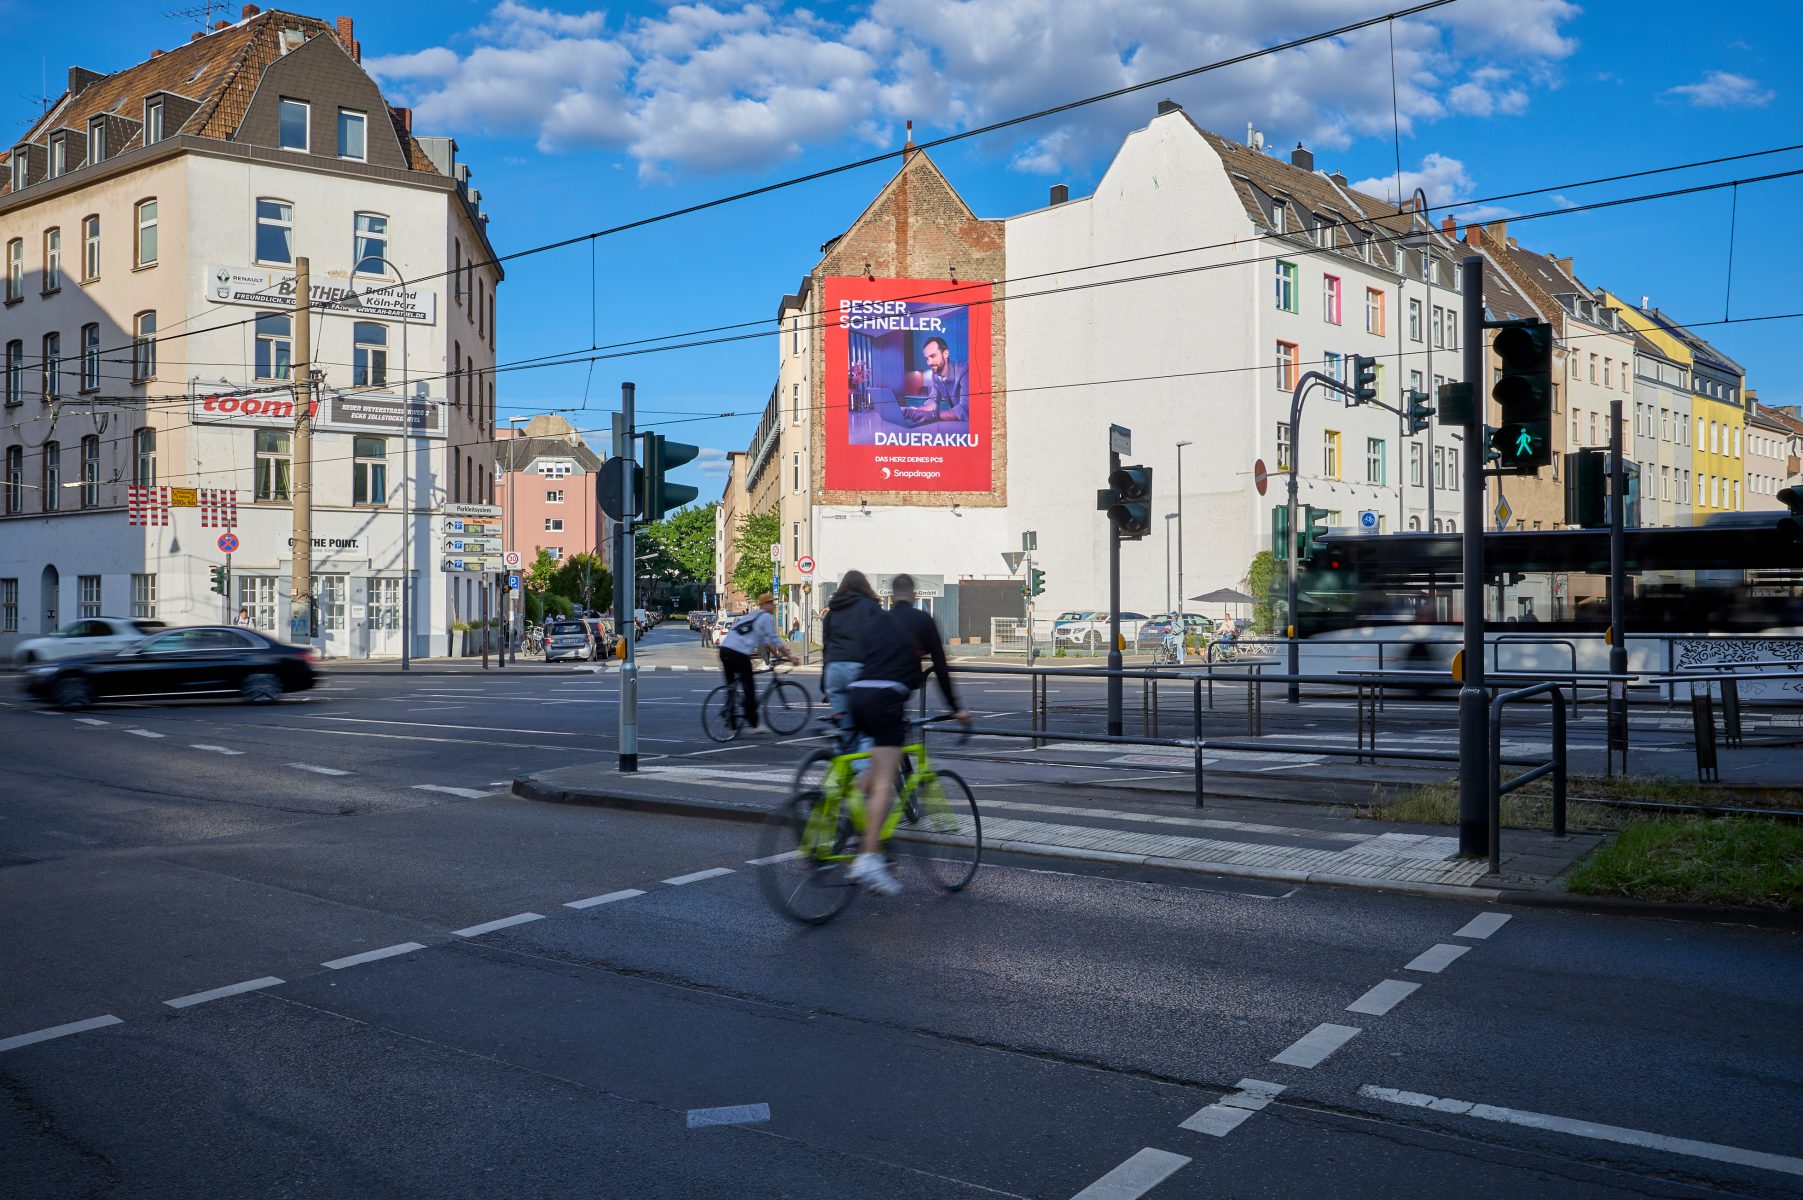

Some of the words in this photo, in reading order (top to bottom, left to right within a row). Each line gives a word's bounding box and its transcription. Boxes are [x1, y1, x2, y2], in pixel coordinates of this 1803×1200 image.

[232, 275, 263, 283] RENAULT
[366, 286, 394, 297] Brühl
[396, 291, 417, 300] und
[366, 297, 416, 310] Köln-Porz
[839, 299, 911, 317] BESSER,
[839, 315, 946, 334] SCHNELLER,
[367, 413, 421, 423] ZOLLSTOCKGRTEL
[874, 432, 979, 448] DAUERAKKU
[893, 469, 941, 479] Snapdragon
[456, 505, 492, 514] Parkleitsystem
[310, 538, 327, 547] THE
[328, 538, 359, 548] POINT.
